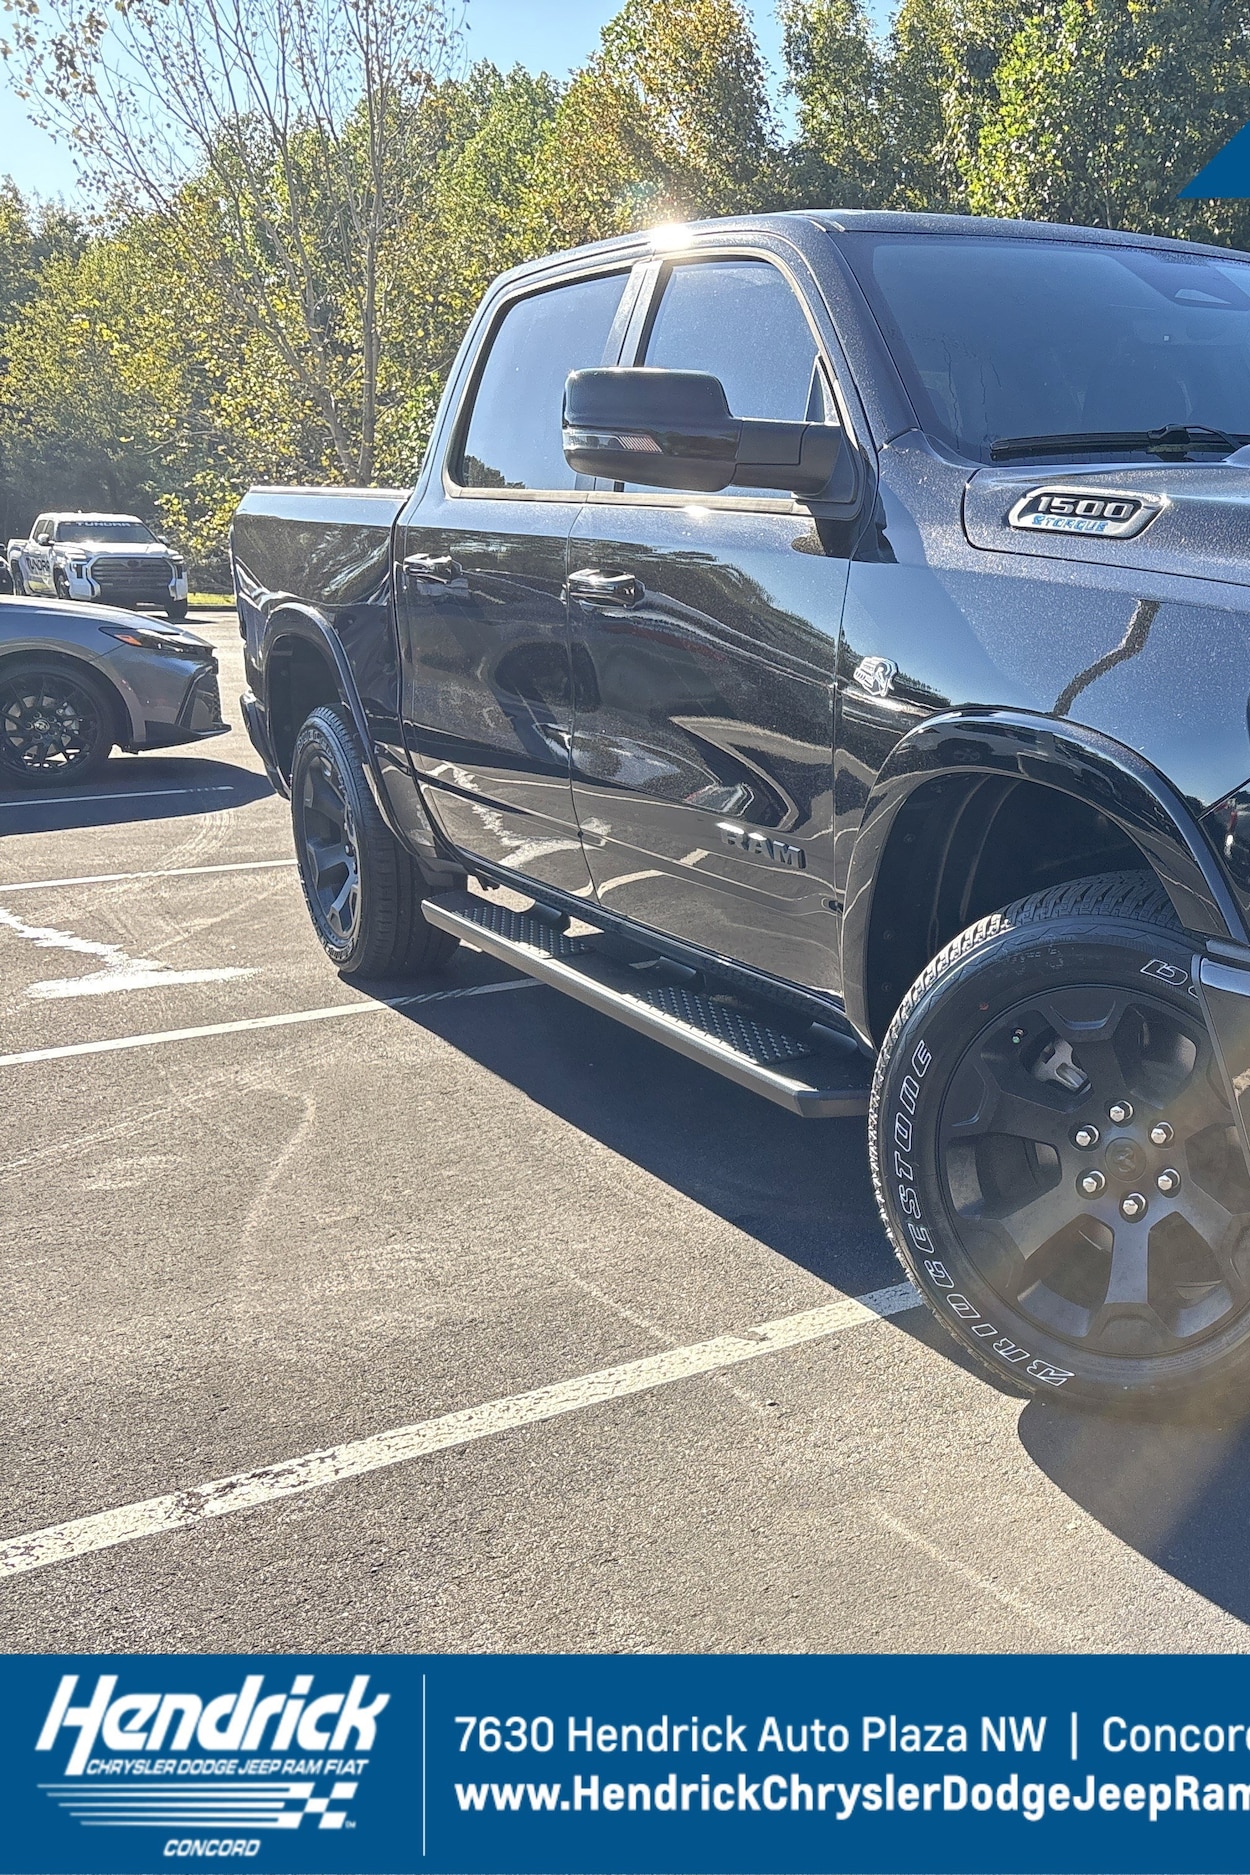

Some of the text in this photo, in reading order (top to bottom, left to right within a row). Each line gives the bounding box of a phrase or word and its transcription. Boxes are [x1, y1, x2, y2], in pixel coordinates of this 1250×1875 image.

[1037, 496, 1134, 519] 1500
[716, 822, 807, 869] RAM
[893, 1040, 1076, 1387] BRIDGESTONE
